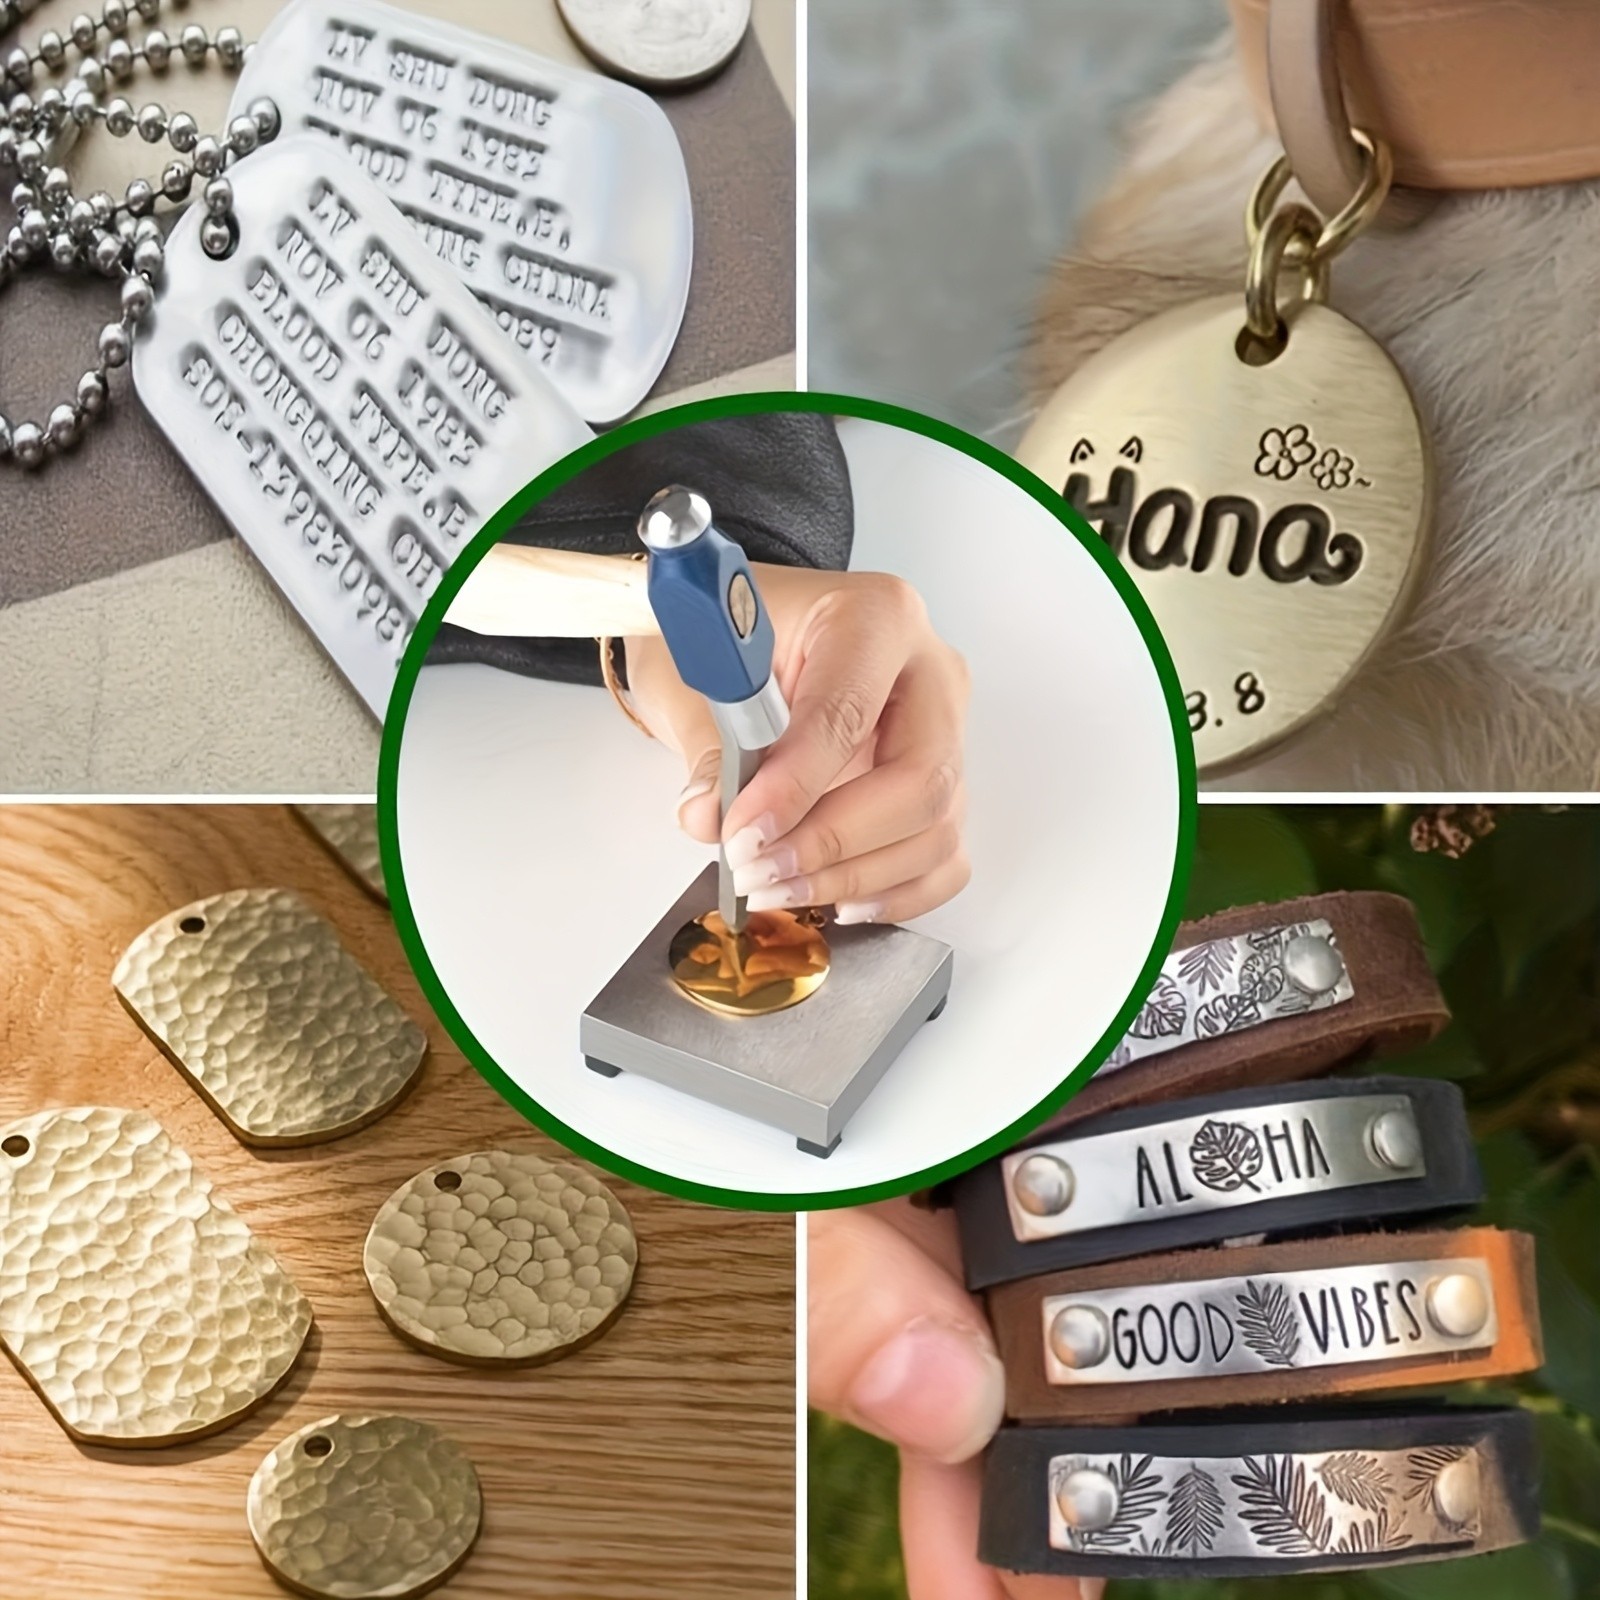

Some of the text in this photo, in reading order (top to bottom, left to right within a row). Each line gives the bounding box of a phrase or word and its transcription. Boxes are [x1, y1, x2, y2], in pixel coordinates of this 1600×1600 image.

[312, 69, 381, 120] NOV
[397, 101, 440, 142] 06
[326, 23, 556, 127] LV SHU DONG
[248, 264, 343, 382] BLOOD
[277, 224, 344, 298] NOV
[350, 307, 392, 362] 06
[308, 182, 514, 419] LV SHU DONG
[500, 246, 613, 321] CHINA
[218, 309, 385, 517] CHONGQING
[1062, 465, 1364, 586] Hana
[1112, 1278, 1423, 1371] GOOD VIBES
